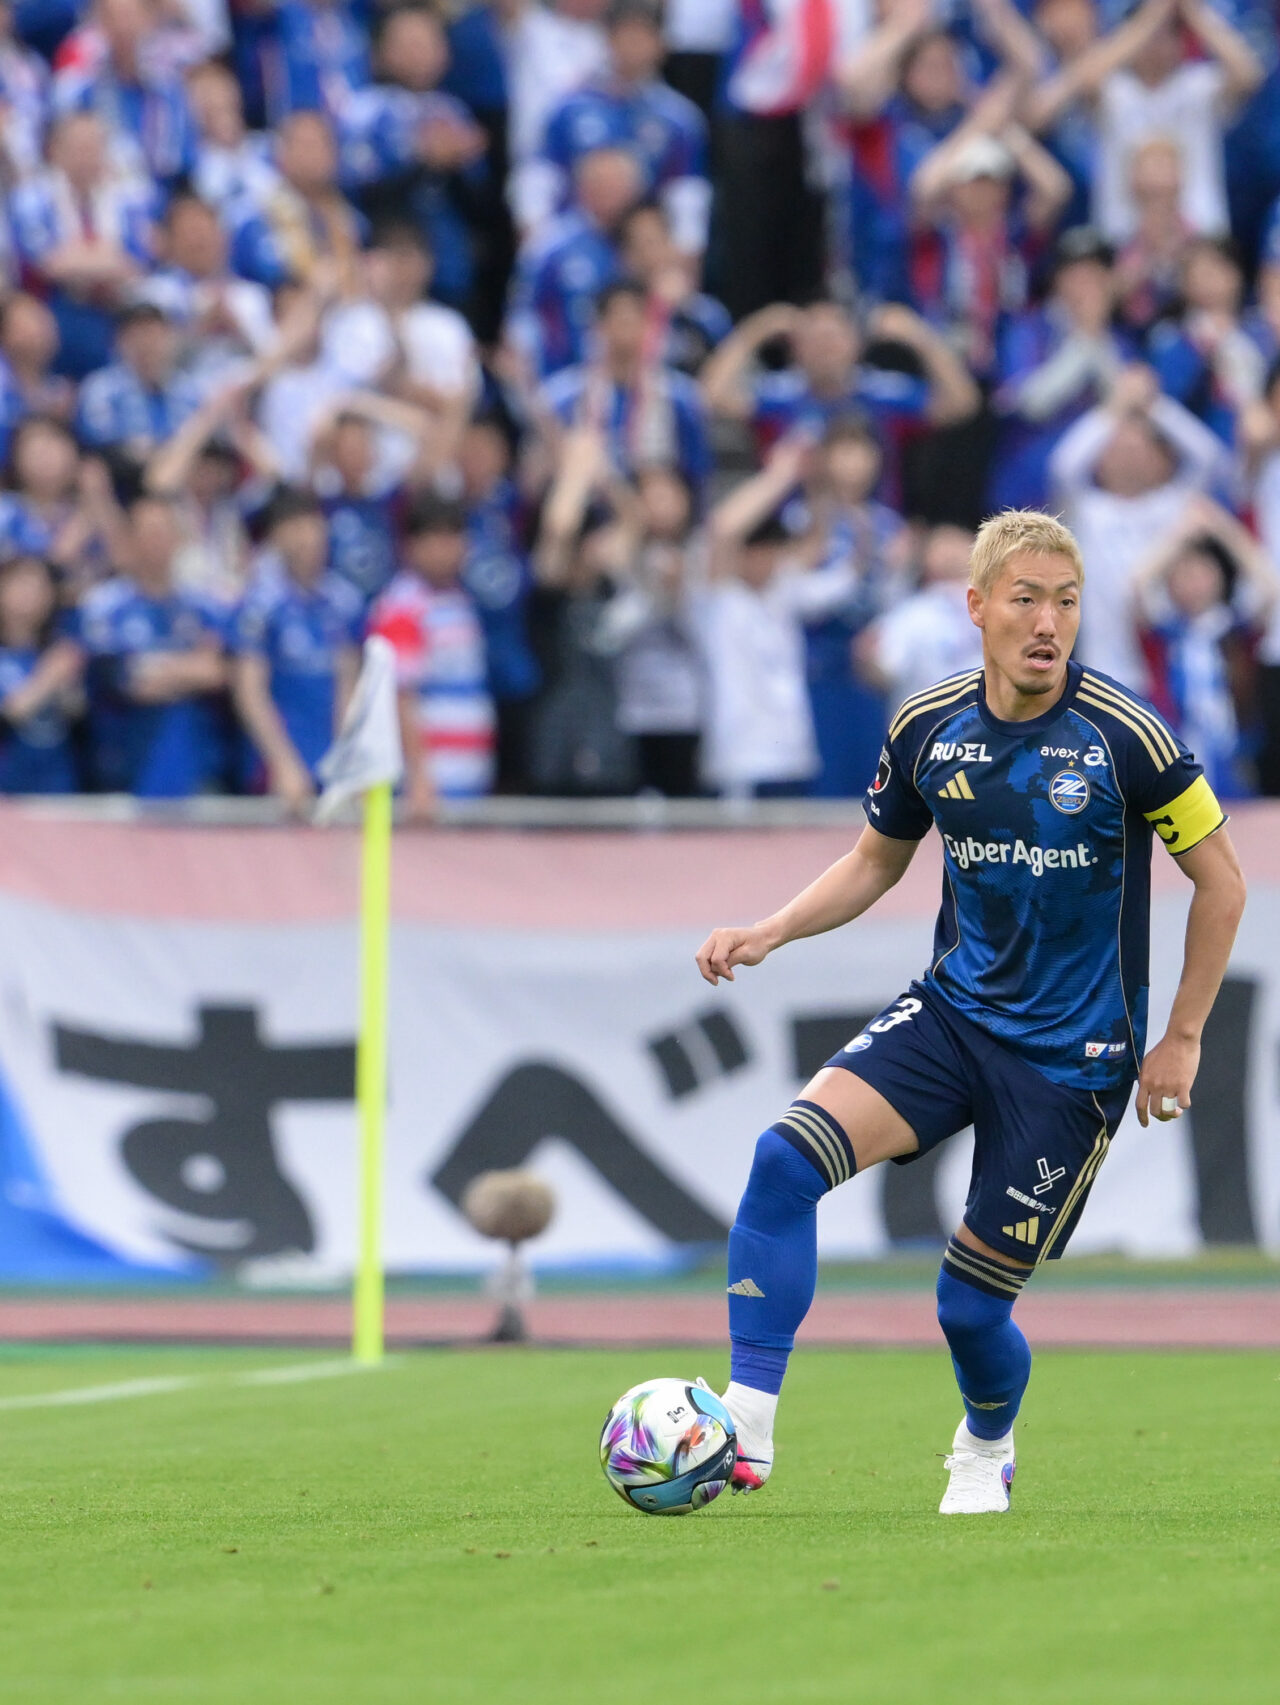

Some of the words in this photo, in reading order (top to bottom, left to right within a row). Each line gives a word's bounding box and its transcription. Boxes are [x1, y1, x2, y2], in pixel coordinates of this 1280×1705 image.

[930, 742, 993, 762] RUDEL
[1040, 745, 1080, 760] avex
[1150, 815, 1180, 845] C
[869, 998, 923, 1032] 3
